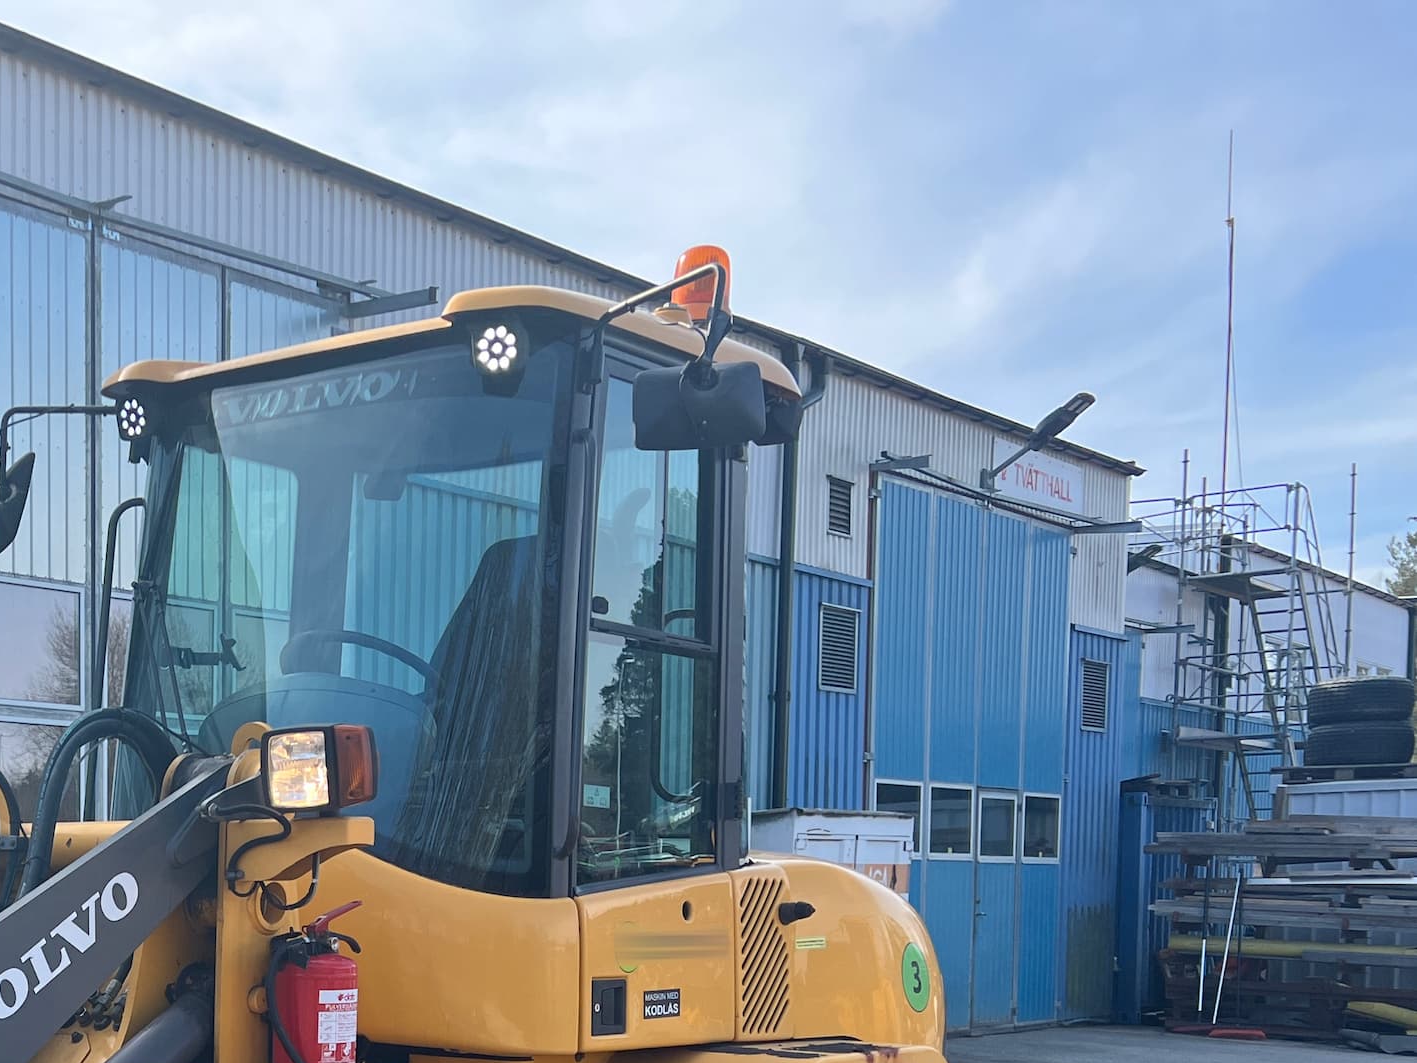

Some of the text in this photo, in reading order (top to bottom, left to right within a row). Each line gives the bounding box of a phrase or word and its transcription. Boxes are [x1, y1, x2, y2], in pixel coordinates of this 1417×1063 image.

[223, 371, 397, 425] VOLVO
[1014, 463, 1073, 502] TVÄTTHALL
[911, 960, 922, 994] 3
[645, 1001, 679, 1017] KODLÅS
